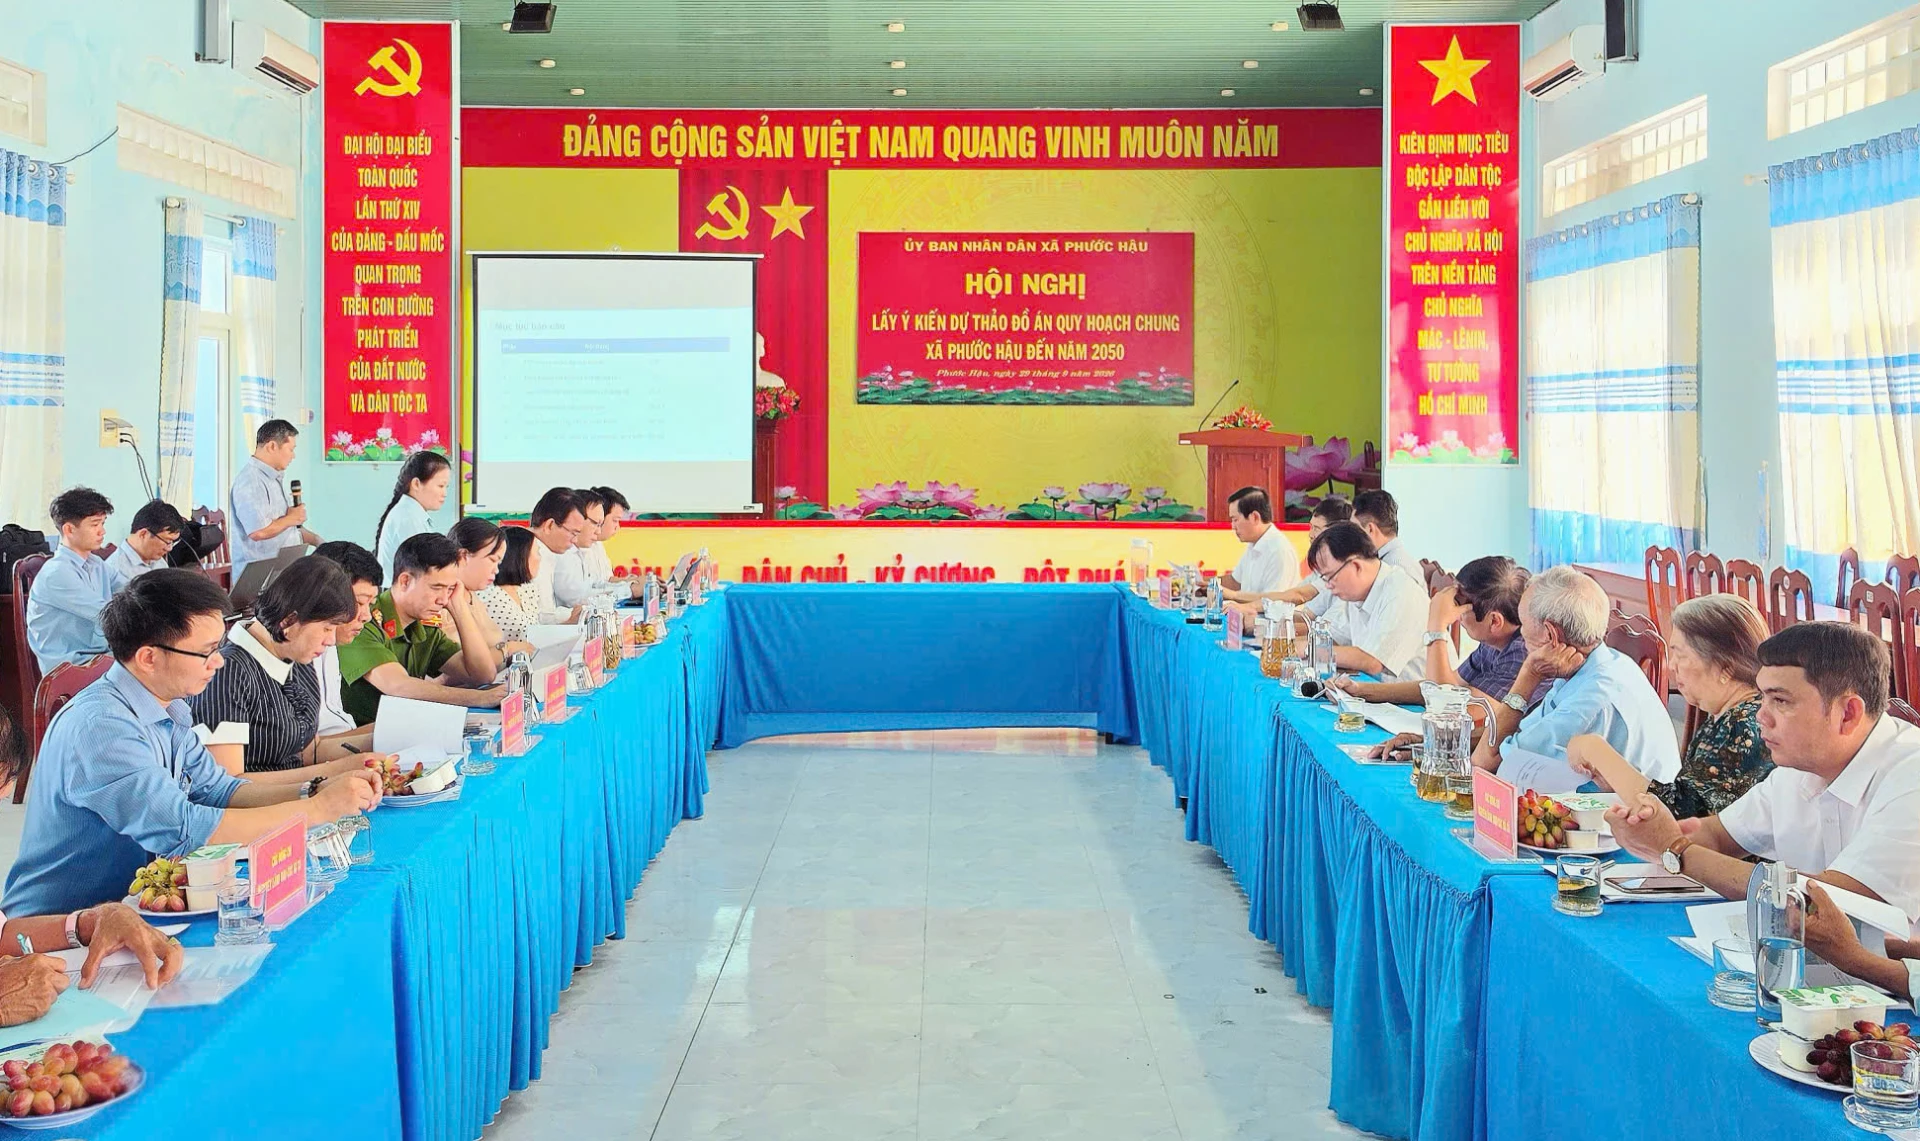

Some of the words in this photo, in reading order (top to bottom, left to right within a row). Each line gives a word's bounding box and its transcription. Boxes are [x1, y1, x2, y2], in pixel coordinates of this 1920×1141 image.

[344, 135, 362, 159] ĐẠI
[366, 132, 383, 159] HỘI
[386, 135, 404, 159] ĐẠI
[407, 129, 432, 155] BIỂU
[563, 114, 641, 157] ĐẢNG
[651, 118, 727, 165] CỘNG
[736, 115, 794, 158] SẢN
[803, 119, 861, 165] VIỆT
[869, 126, 934, 158] NAM
[943, 125, 1036, 162] QUANG
[1045, 125, 1110, 158] VINH
[1120, 119, 1203, 158] MUÔN
[1213, 118, 1278, 158] NĂM
[1428, 134, 1454, 158] ĐỊNH
[1458, 134, 1482, 158] MỤC
[1485, 131, 1509, 154] TIÊU
[358, 164, 386, 187] TOÀN
[389, 162, 418, 189] QUỐC
[1406, 164, 1429, 191] ĐỘC
[1432, 164, 1452, 191] LẬP
[1455, 164, 1477, 187] DÂN
[1480, 163, 1502, 191] TỘC
[356, 194, 377, 219] LẦN
[380, 196, 401, 219] THỨ
[403, 200, 420, 219] XIV
[1419, 192, 1441, 220] GẮN
[1444, 193, 1469, 220] LIỀN
[1472, 195, 1489, 220] VỚI
[331, 226, 353, 252] CỦA
[356, 226, 386, 252] ĐẢNG
[395, 226, 417, 252] DẤU
[420, 226, 445, 252] MỐC
[904, 238, 924, 252] ỦY
[929, 241, 958, 252] BAN
[962, 239, 1002, 252] NHÂN
[1006, 239, 1036, 252] DÂN
[1041, 239, 1060, 252] XÃ
[1065, 239, 1114, 252] PHƯỚC
[1118, 239, 1148, 254] HẬU
[1405, 226, 1427, 252] CHỦ
[1430, 229, 1463, 252] NGHĨA
[1466, 228, 1481, 252] XÃ
[1485, 228, 1503, 256] HỘI
[355, 264, 383, 286] QUAN
[386, 264, 421, 288] TRỌNG
[965, 268, 1012, 299] HỘI
[1022, 273, 1086, 300] NGHỊ
[1411, 261, 1439, 285] TRÊN
[1467, 259, 1497, 285] TẢNG
[342, 293, 369, 316] TRÊN
[372, 297, 394, 316] CON
[397, 292, 434, 316] ĐƯỜNG
[1424, 291, 1446, 317] CHỦ
[1449, 295, 1483, 317] NGHĨA
[872, 309, 898, 331] LẤY
[901, 310, 910, 331] Ý
[914, 309, 946, 331] KIẾN
[950, 311, 969, 334] DỰ
[972, 309, 1008, 331] THẢO
[1011, 308, 1030, 331] ĐỒ
[1034, 311, 1052, 331] ÁN
[1056, 314, 1082, 334] QUY
[1086, 315, 1131, 335] HOẠCH
[1135, 315, 1180, 332] CHUNG
[357, 325, 385, 348] PHÁT
[387, 322, 418, 348] TRIỂN
[1417, 327, 1443, 350] MÁC
[925, 340, 943, 360] XÃ
[947, 339, 992, 360] PHƯỚC
[995, 340, 1023, 363] HẬU
[1026, 338, 1054, 361] ĐẾN
[1058, 340, 1087, 361] NĂM
[1091, 343, 1125, 361] 2050
[349, 355, 371, 381] CỦA
[374, 355, 394, 381] ĐẤT
[396, 357, 426, 381] NƯỚC
[1427, 361, 1442, 383] TƯ
[350, 390, 365, 413] VÀ
[368, 389, 390, 413] DÂN
[393, 390, 413, 417] TỘC
[415, 393, 428, 413] TA
[1437, 392, 1455, 416] CHÍ
[1458, 394, 1488, 416] MINH
